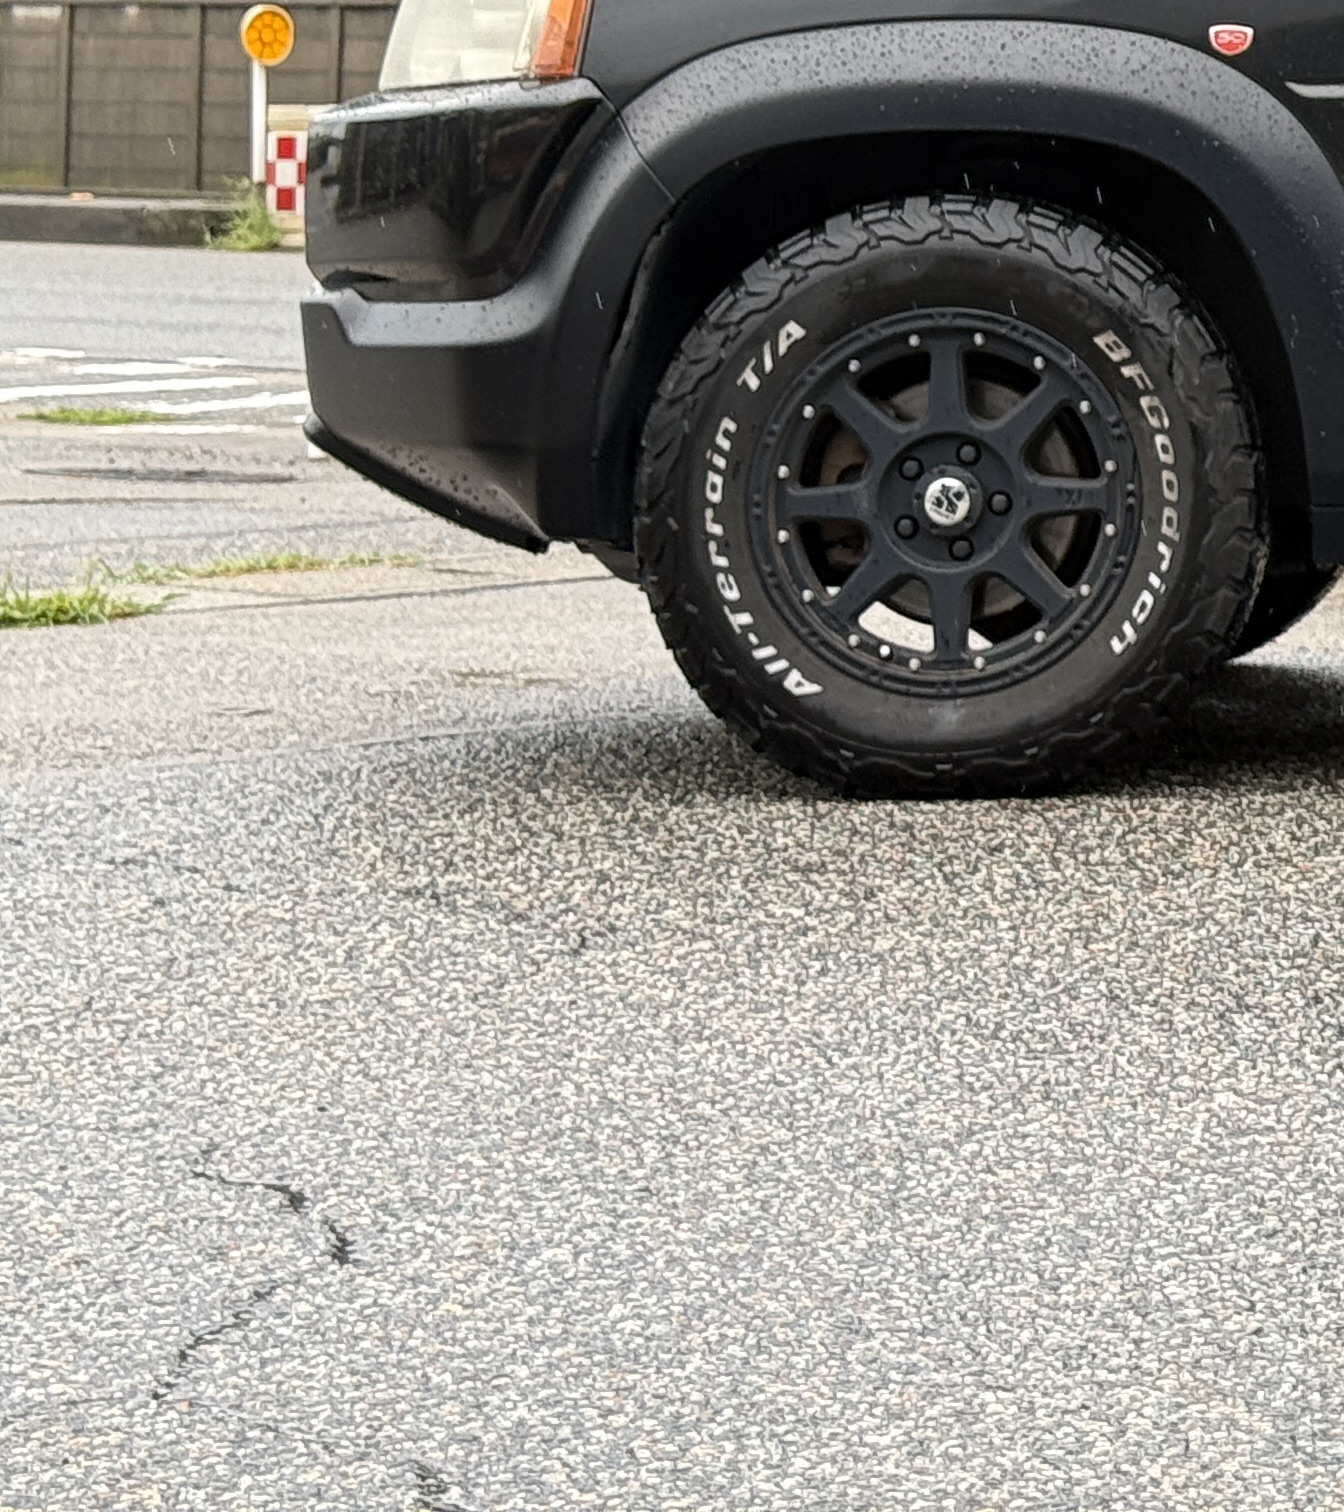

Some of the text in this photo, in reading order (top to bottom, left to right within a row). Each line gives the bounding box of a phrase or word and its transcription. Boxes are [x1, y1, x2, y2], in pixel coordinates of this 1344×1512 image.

[704, 319, 823, 696] All-Terrain T/A
[1093, 330, 1180, 655] BFGoodrich
